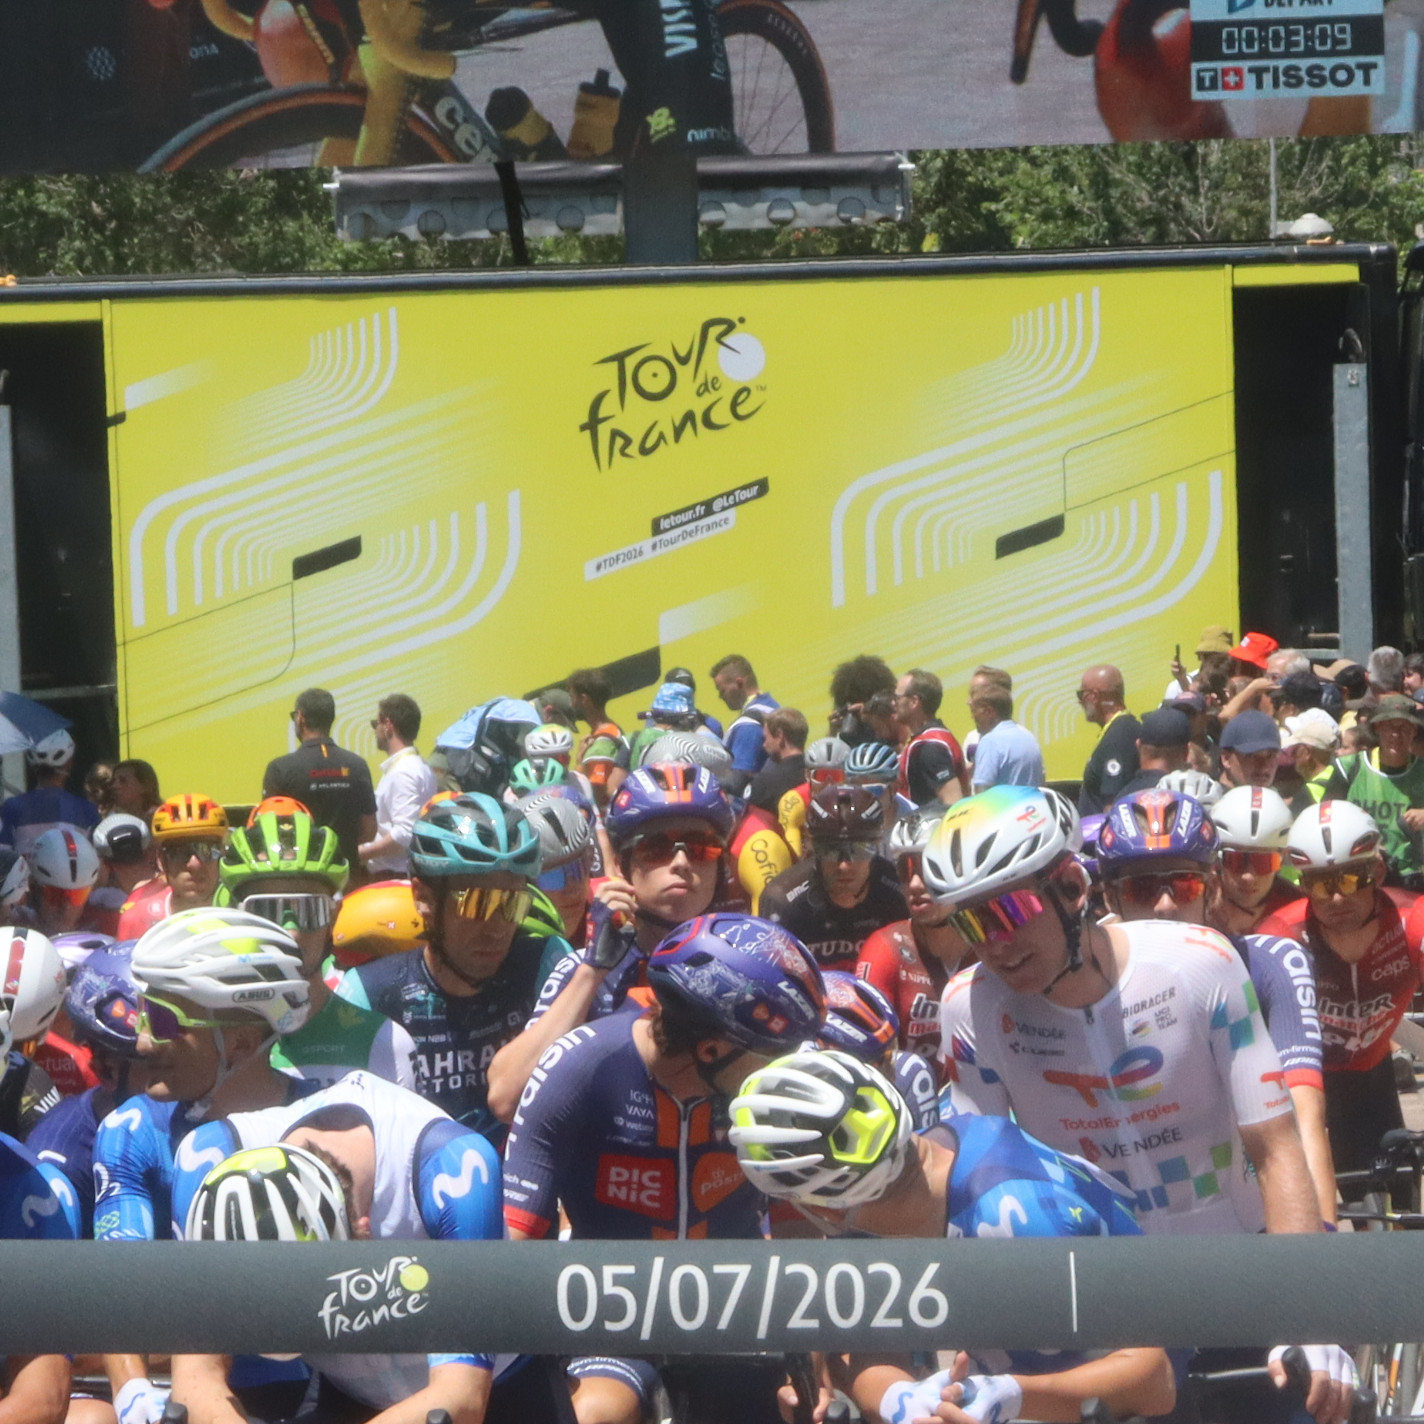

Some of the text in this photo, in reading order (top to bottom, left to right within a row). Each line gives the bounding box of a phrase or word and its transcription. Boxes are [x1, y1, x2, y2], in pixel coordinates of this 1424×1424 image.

[1222, 24, 1351, 54] 00:03:09
[1248, 62, 1378, 90] TISSOT
[592, 316, 747, 409] TOUR
[696, 371, 722, 397] de
[579, 386, 766, 473] france
[660, 484, 759, 531] letour.fr @LeTour
[595, 515, 730, 573] #TDF2026 #TourDeFrance
[1122, 986, 1176, 1019] BIORACER
[513, 1024, 597, 1126] raisin
[626, 1104, 655, 1120] VAYA
[326, 1255, 419, 1308] TOUR
[387, 1283, 403, 1299] de
[556, 1255, 950, 1341] 05/07/2026
[318, 1290, 429, 1340] france
